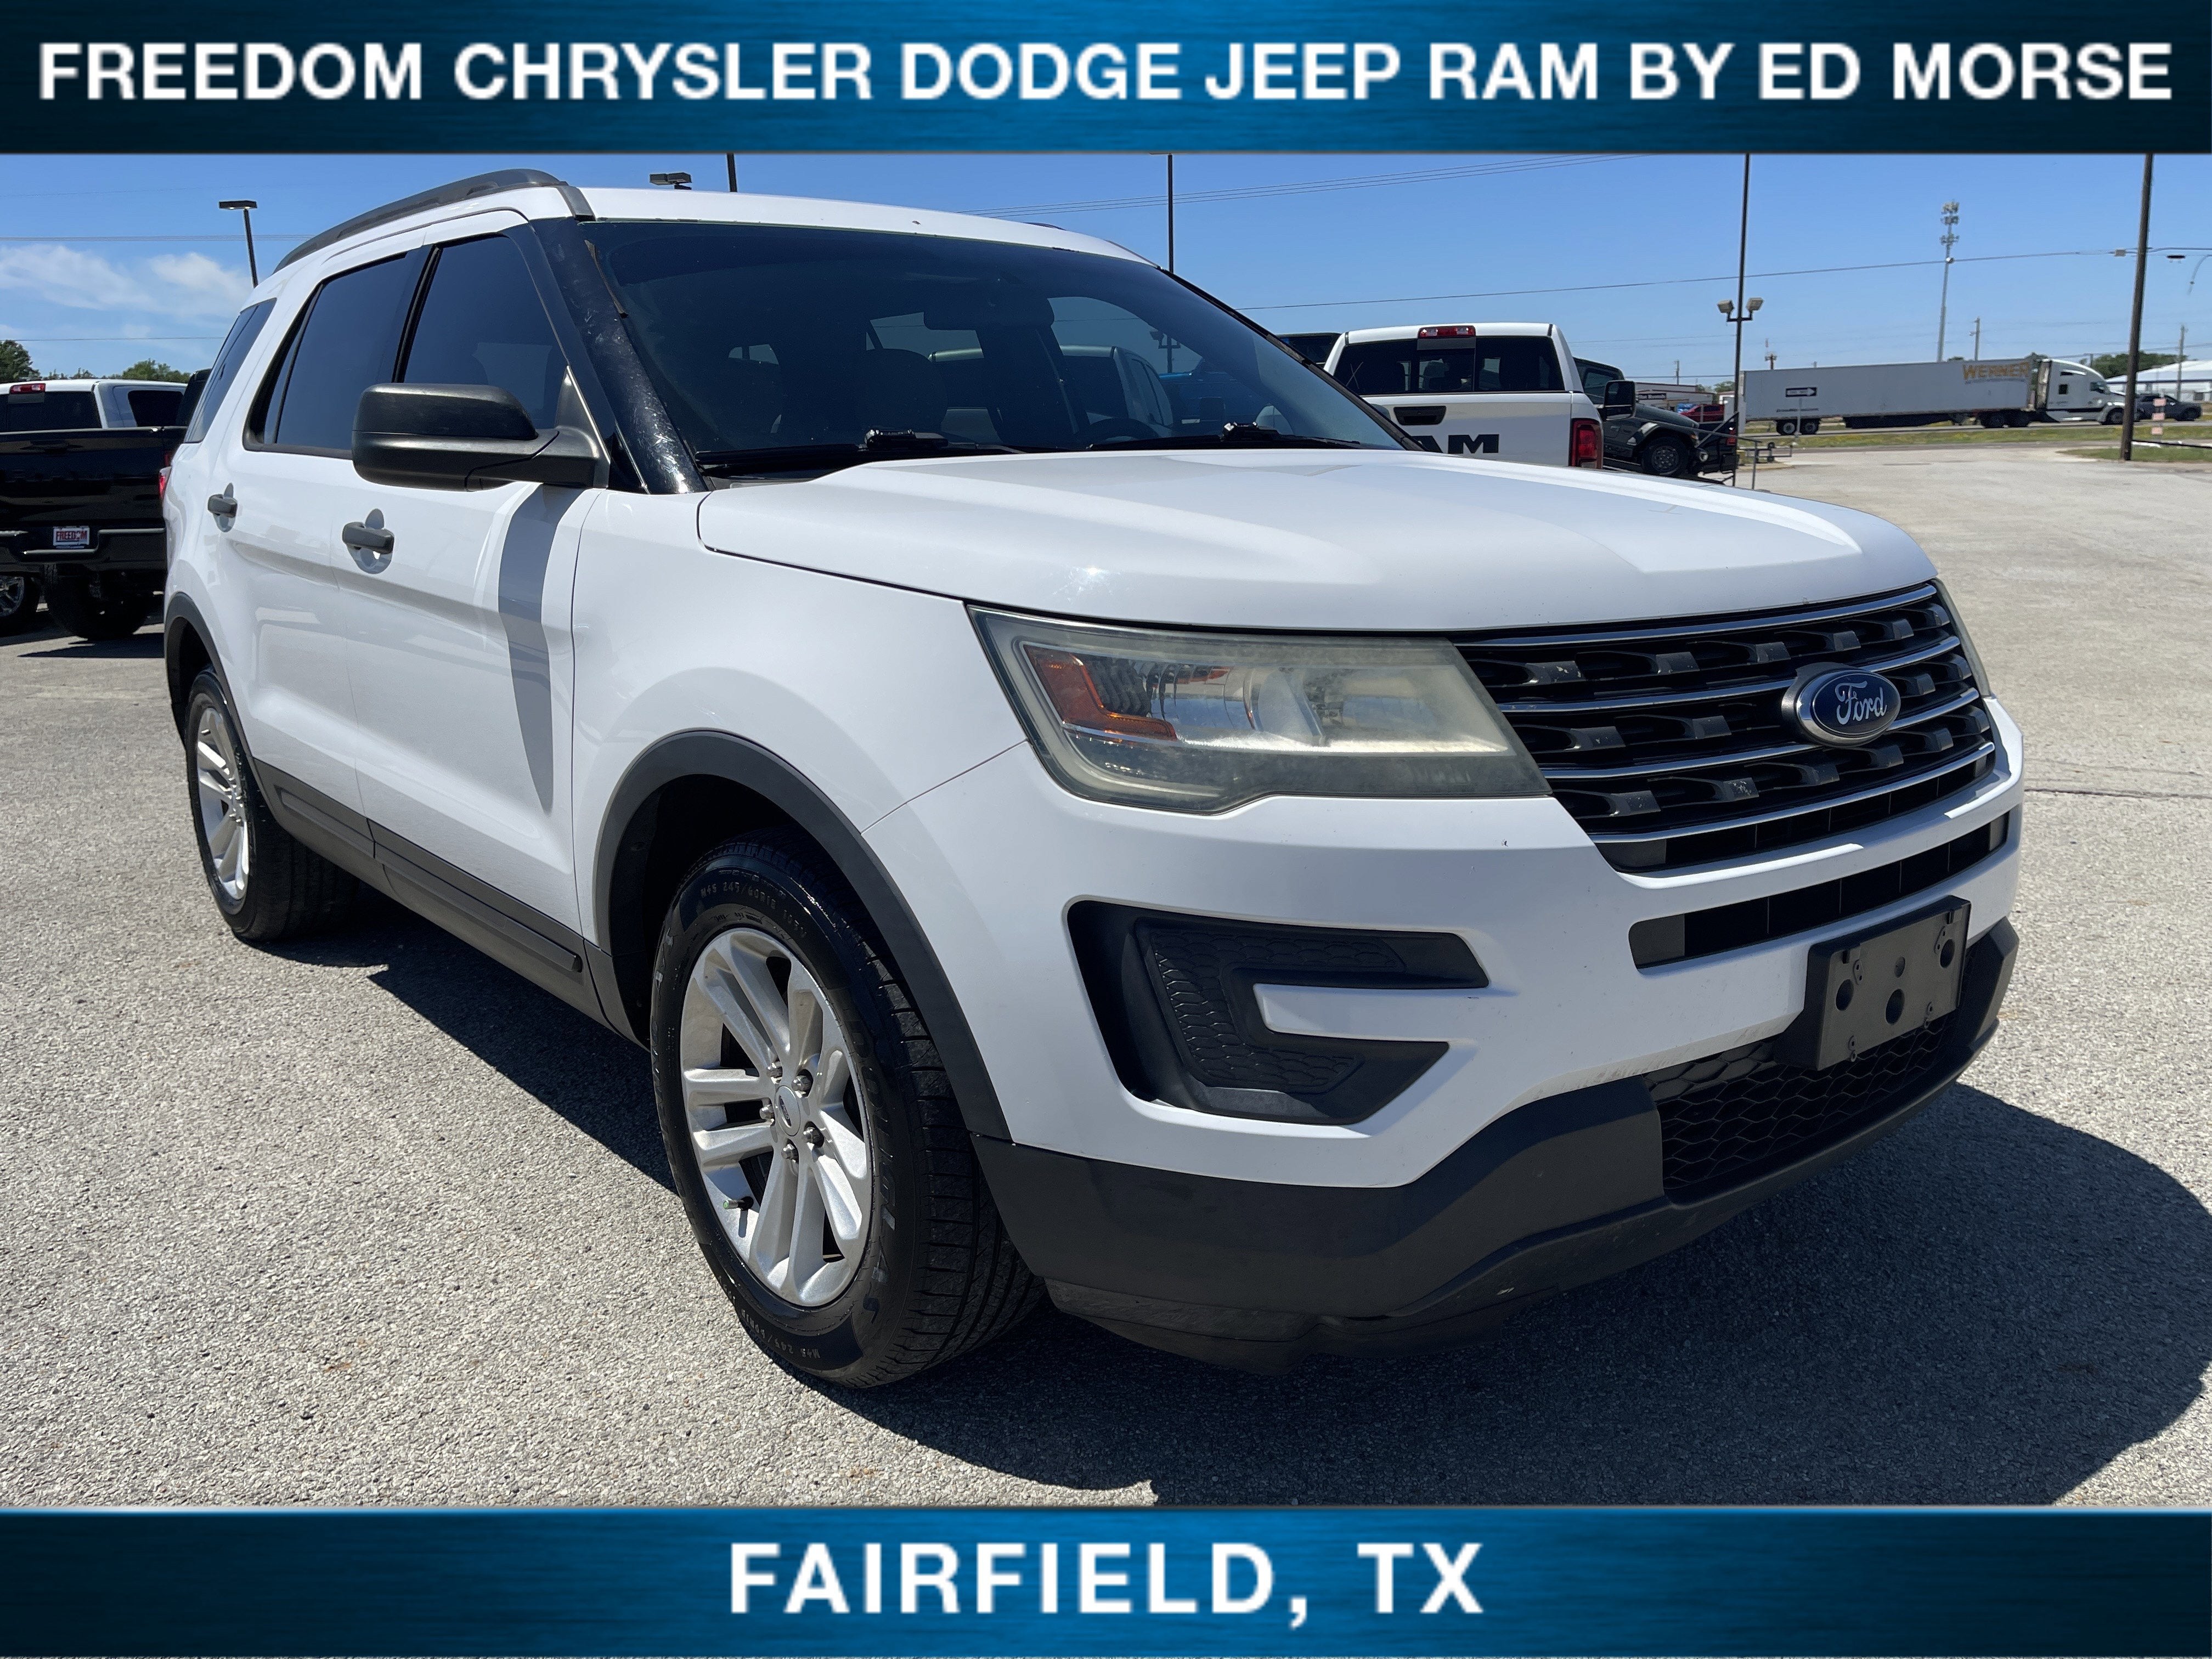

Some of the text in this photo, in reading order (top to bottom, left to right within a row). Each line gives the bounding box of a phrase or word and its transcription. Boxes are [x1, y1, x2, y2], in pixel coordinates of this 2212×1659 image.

[1411, 434, 1499, 454] AM
[56, 531, 87, 540] FREEDOM
[1835, 680, 1888, 725] Ford
